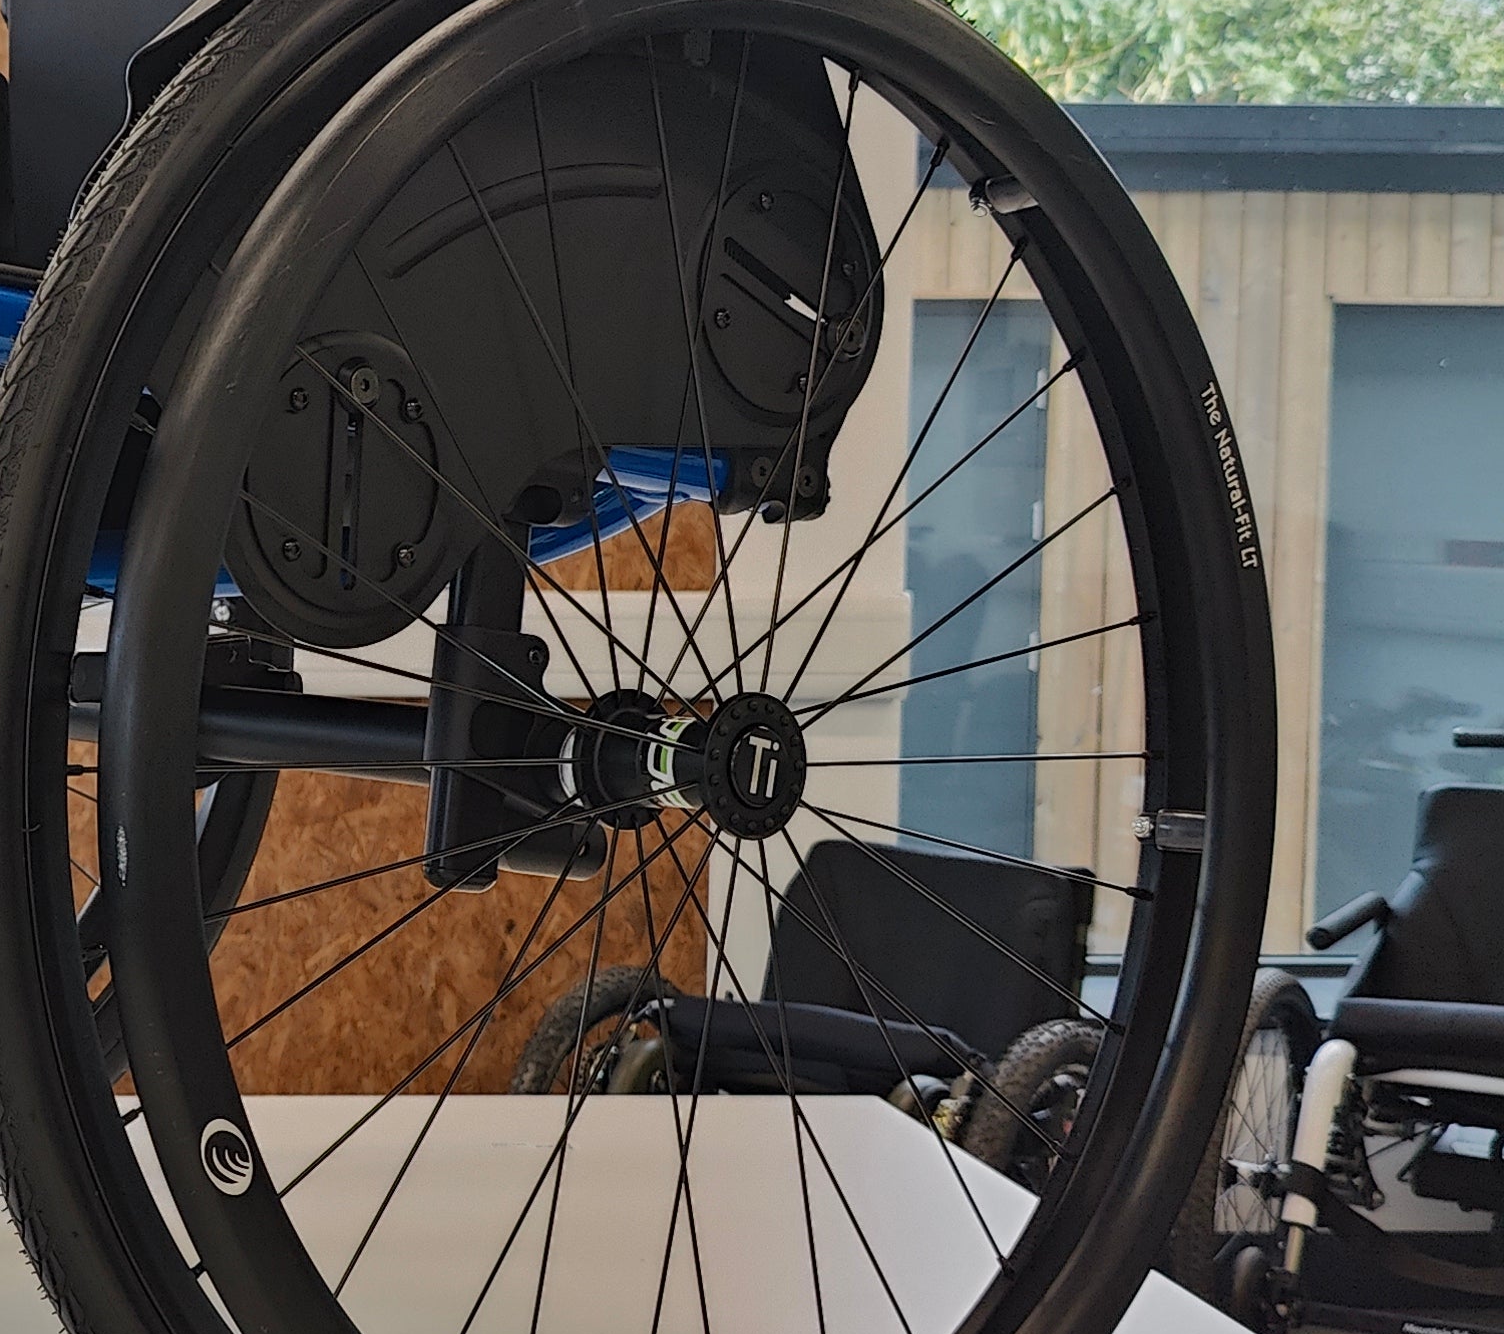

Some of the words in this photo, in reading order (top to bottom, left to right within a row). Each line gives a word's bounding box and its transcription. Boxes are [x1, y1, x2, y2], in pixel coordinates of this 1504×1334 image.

[1200, 381, 1222, 426] The
[1214, 428, 1252, 543] Natural-Fit
[1240, 546, 1259, 568] LT
[748, 735, 780, 799] Ti
